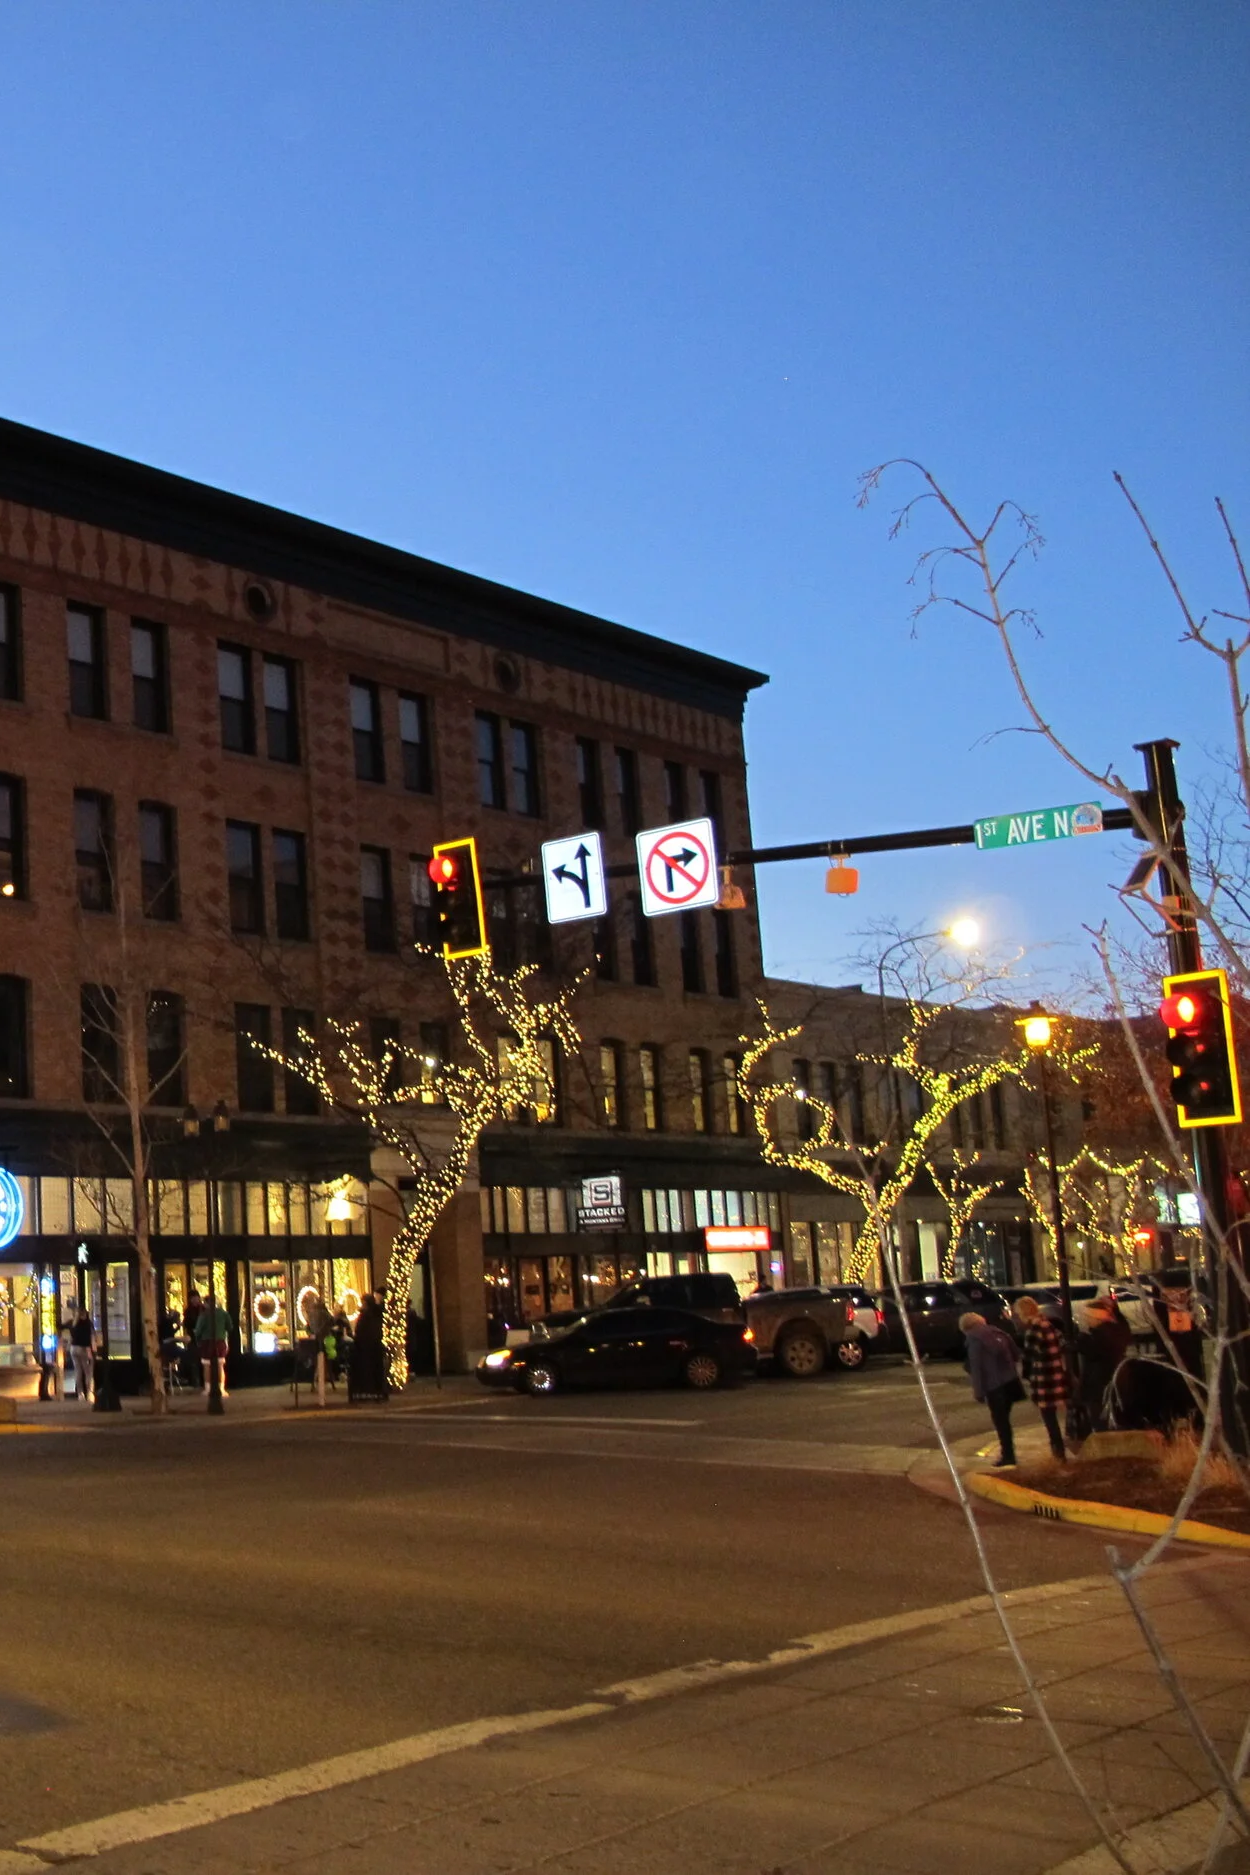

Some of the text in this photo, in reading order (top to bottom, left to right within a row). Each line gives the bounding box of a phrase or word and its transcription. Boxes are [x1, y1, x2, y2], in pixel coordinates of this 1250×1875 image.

[975, 810, 1069, 848] 1ST AVE N
[594, 1184, 610, 1201] S
[578, 1206, 626, 1218] STACKED
